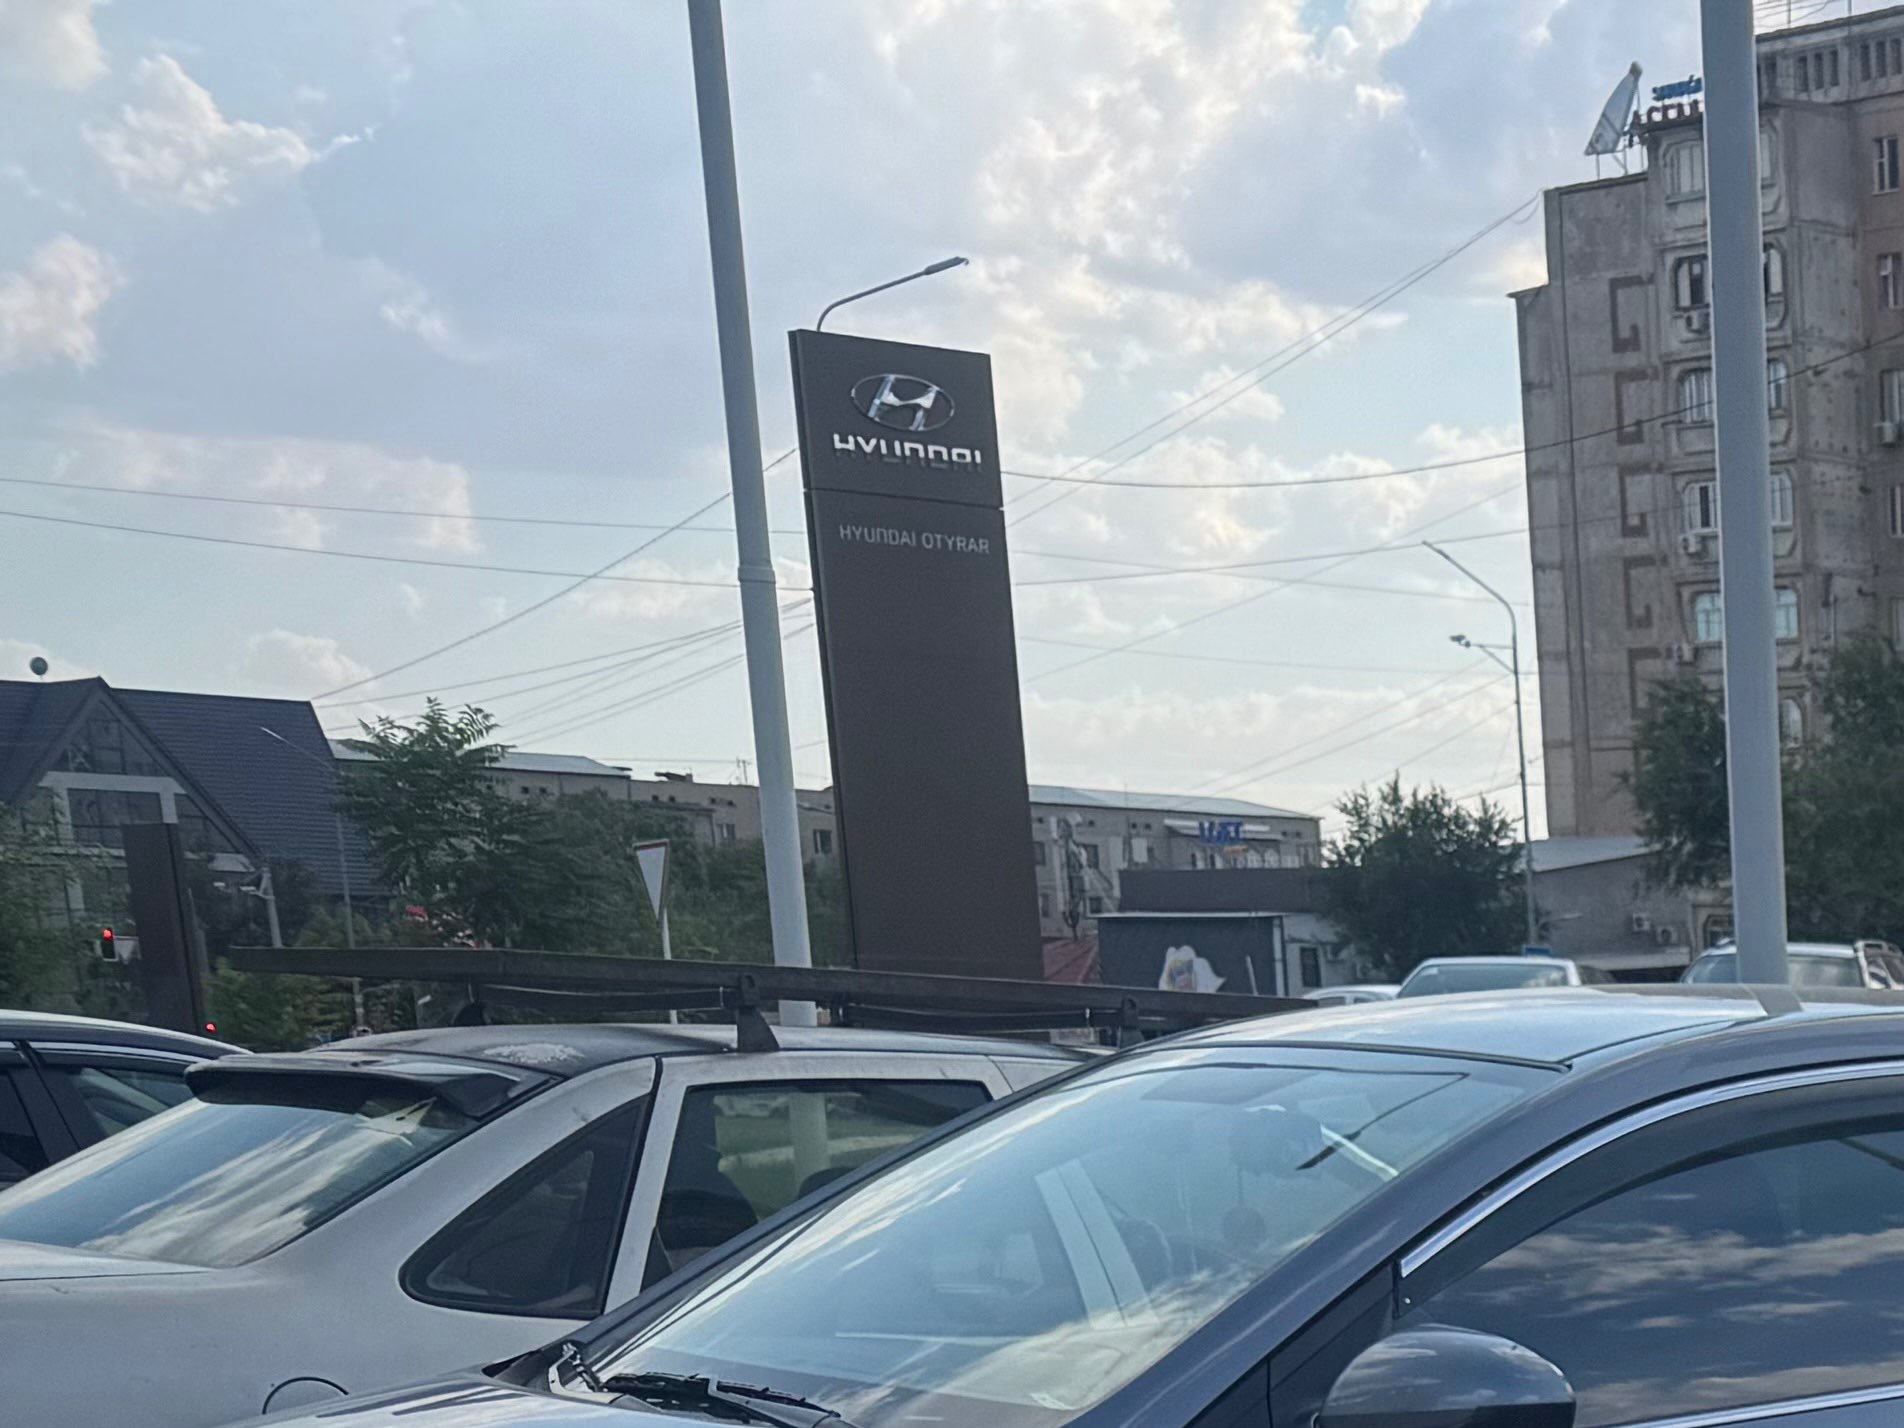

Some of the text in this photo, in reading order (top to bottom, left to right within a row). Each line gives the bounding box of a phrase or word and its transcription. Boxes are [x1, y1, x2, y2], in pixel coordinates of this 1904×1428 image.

[833, 433, 982, 464] HYUNDAI
[839, 524, 990, 554] HYUNDAI OTYRAR
